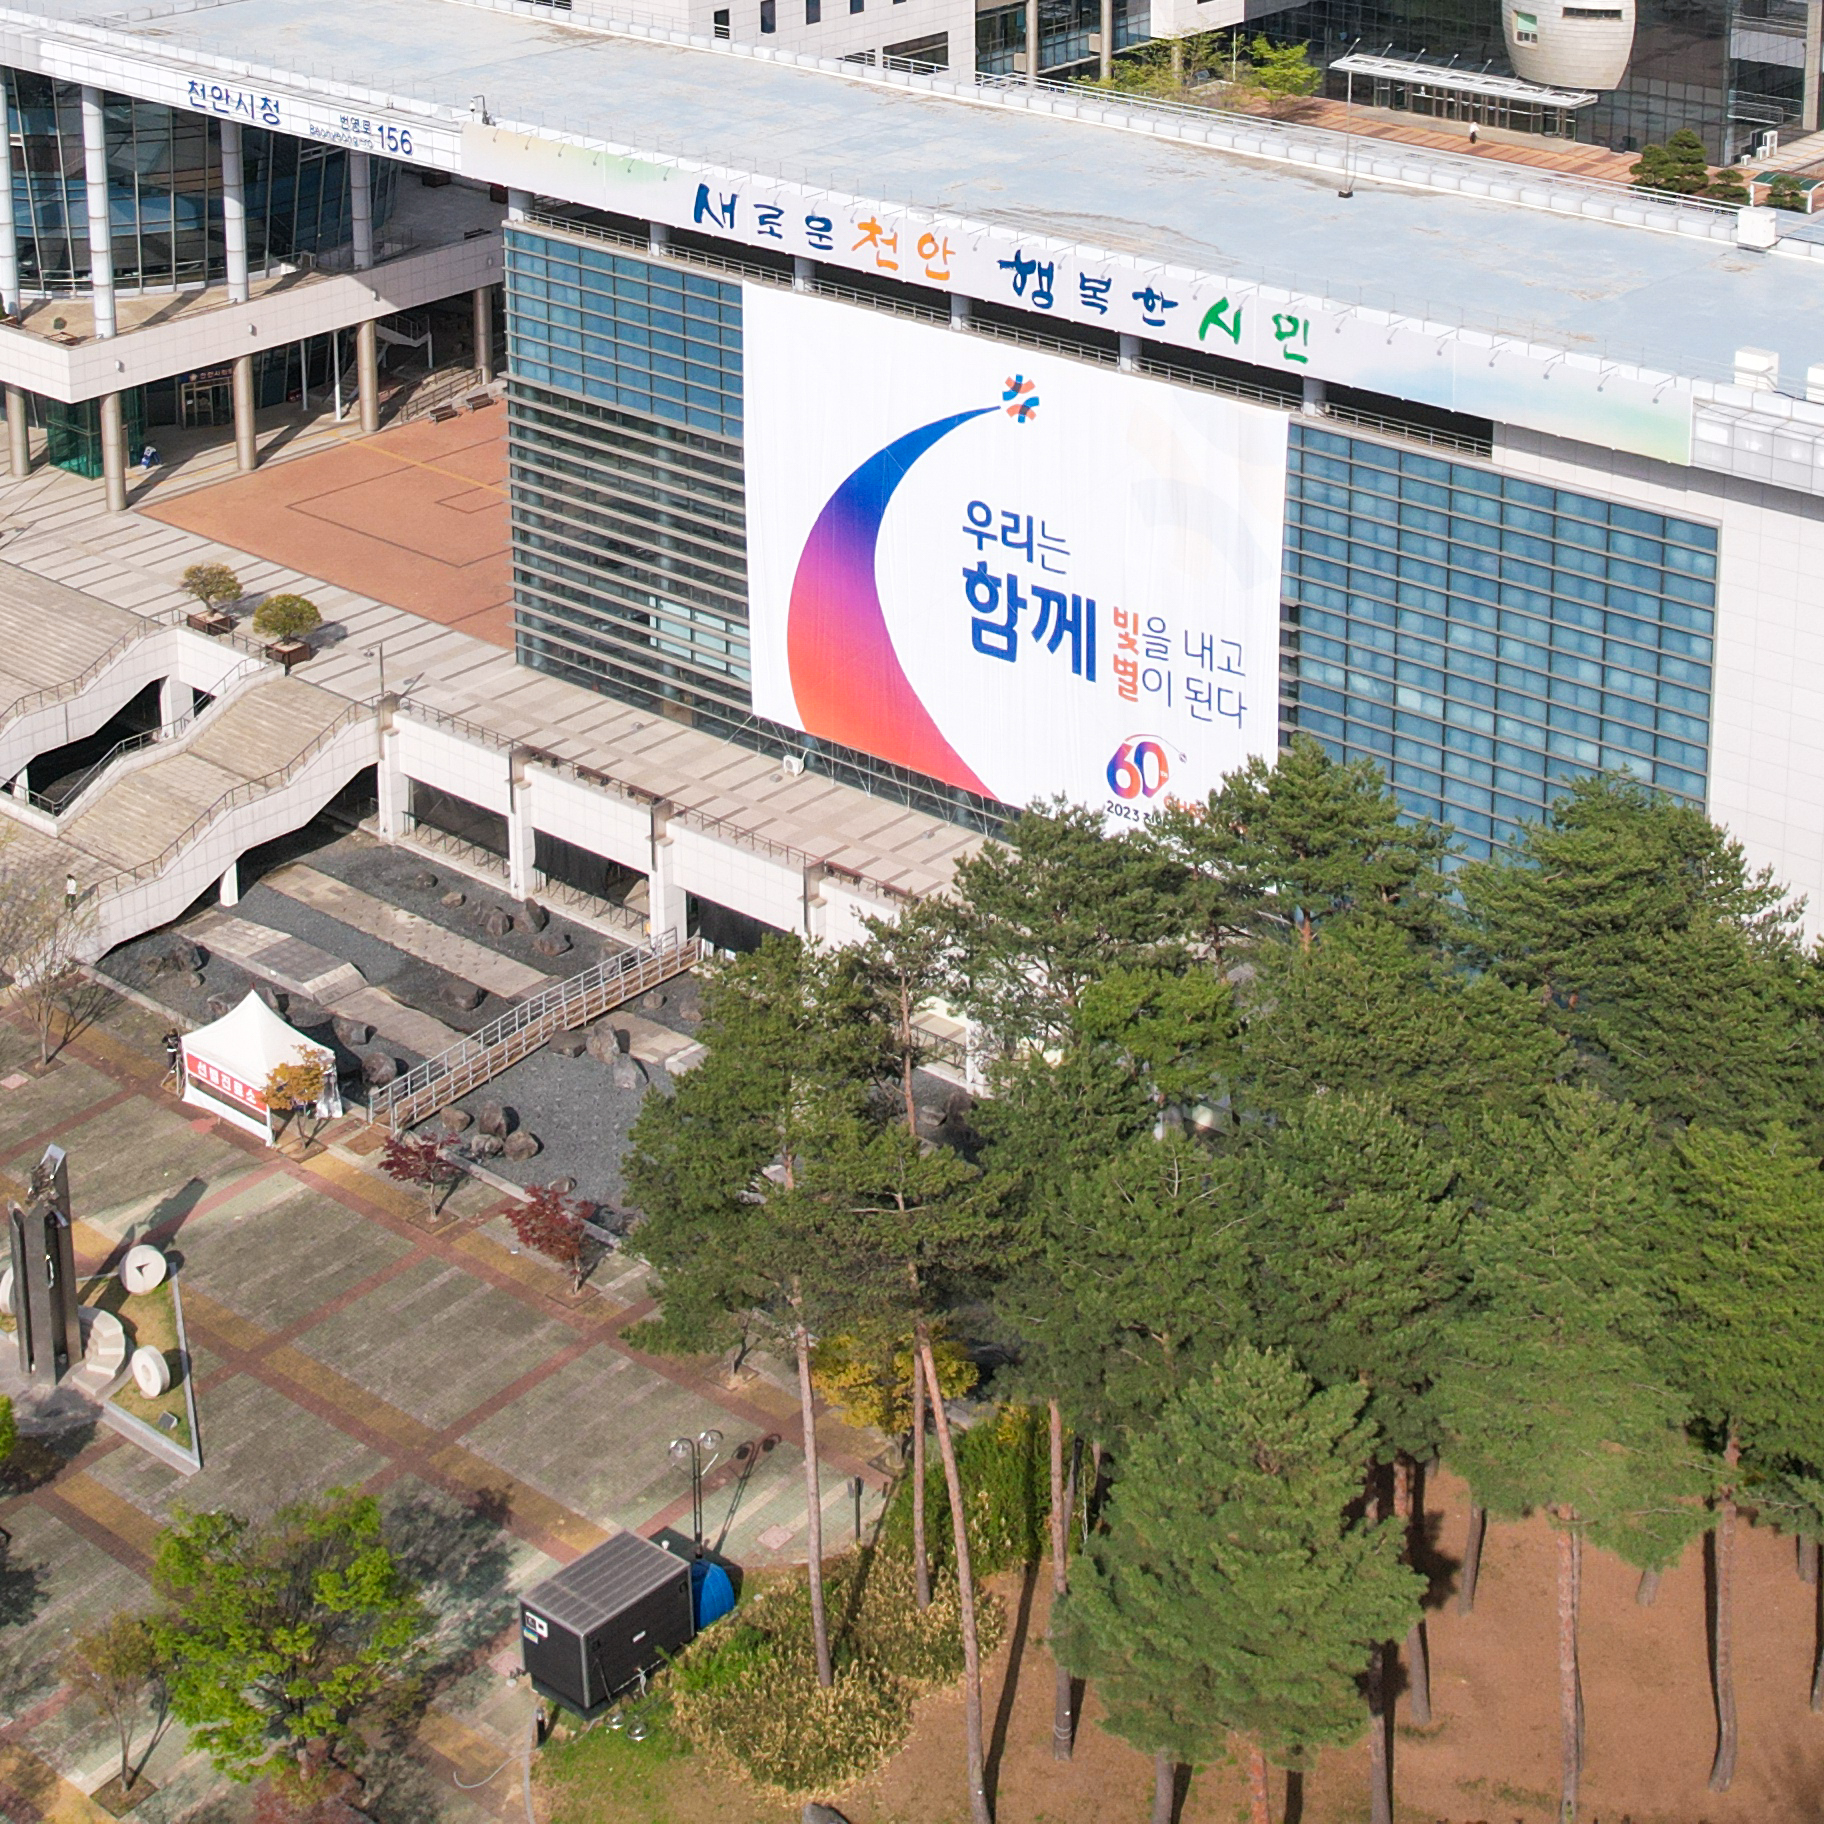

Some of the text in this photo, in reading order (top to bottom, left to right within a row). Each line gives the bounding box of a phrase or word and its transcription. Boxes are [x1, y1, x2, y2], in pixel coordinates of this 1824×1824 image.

[187, 79, 281, 126] 천안시청
[339, 114, 414, 156] 번영로 156
[693, 182, 1310, 364] 새로운 천안 행복한 시민
[962, 499, 1071, 575] 우리는
[962, 560, 1097, 683] 함께
[1113, 605, 1246, 677] 빛을 내고
[1113, 653, 1248, 729] 별이 된다
[1106, 799, 1140, 823] 2023
